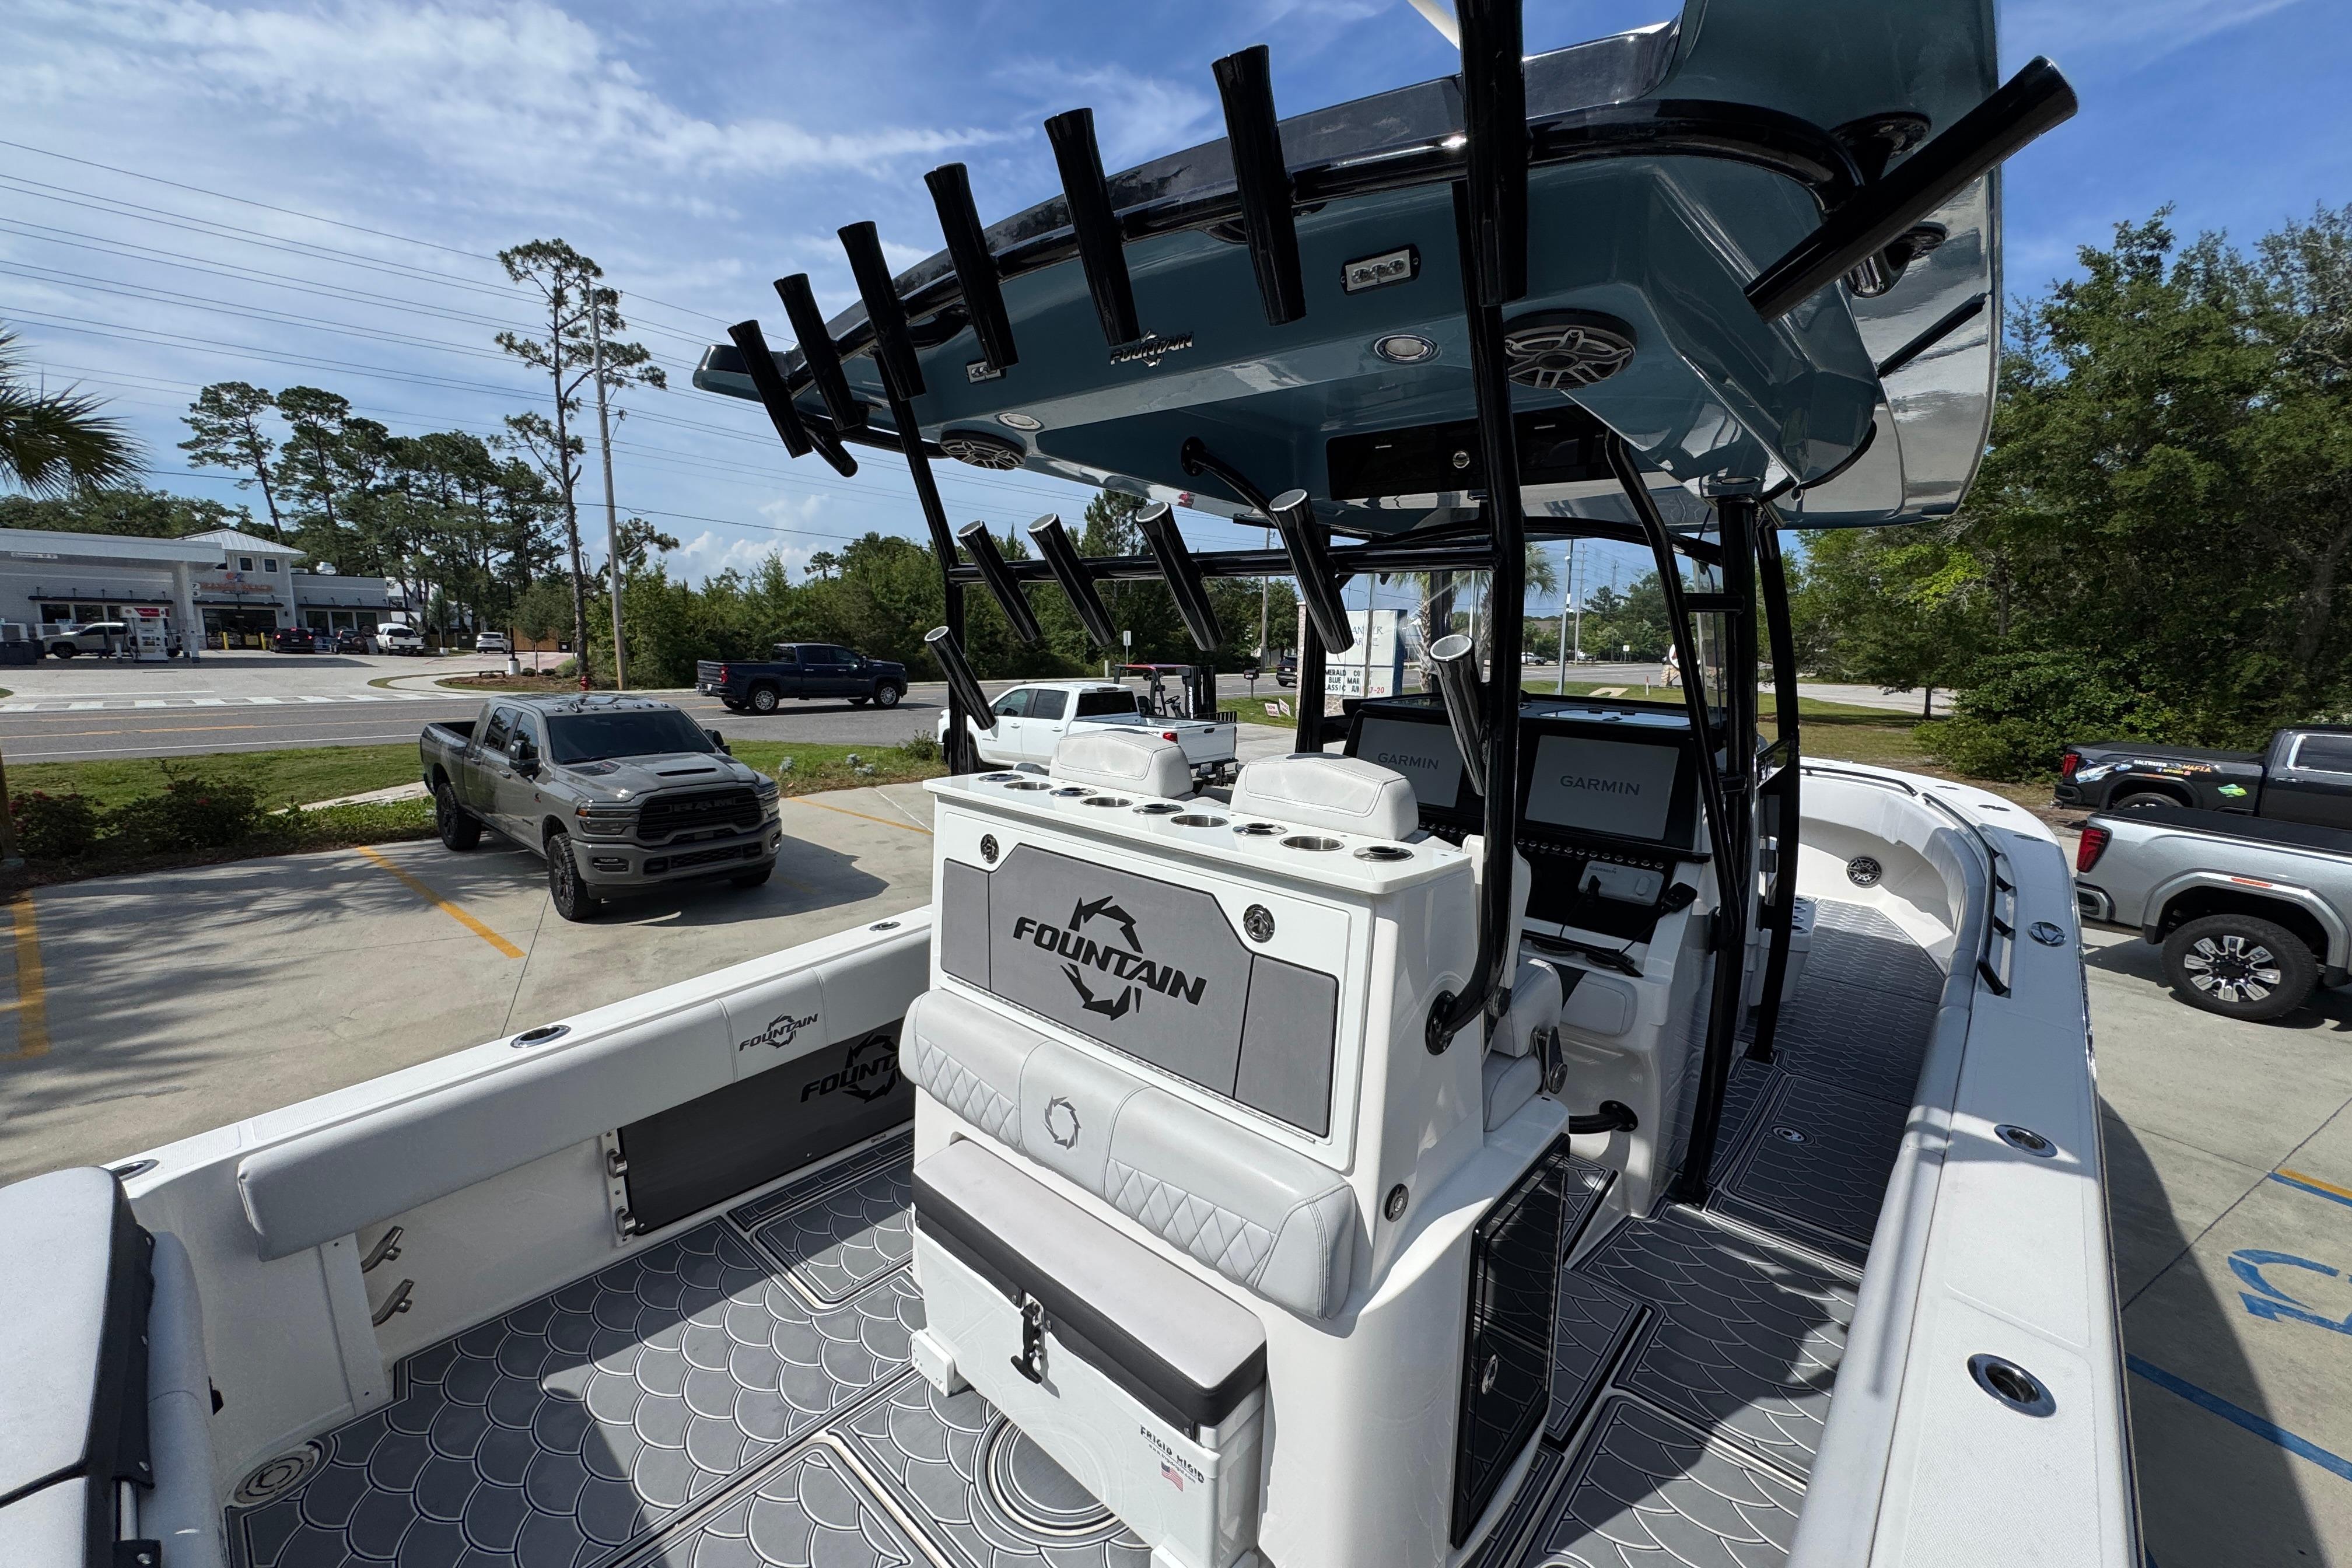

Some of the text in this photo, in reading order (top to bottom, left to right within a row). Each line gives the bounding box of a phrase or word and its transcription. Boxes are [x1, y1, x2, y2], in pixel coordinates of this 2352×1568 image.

[1110, 332, 1194, 365] FOUNTAIN
[1377, 752, 1439, 769] GARMIN
[2133, 760, 2212, 773] SALTWATER MAFIA
[1560, 775, 1640, 796] GARMIN
[674, 798, 734, 812] RAM
[1013, 916, 1208, 1006] FOUNTAIN
[738, 1013, 818, 1051] FOUNTAIN
[800, 1051, 899, 1103] FOUNT
[1140, 1424, 1172, 1455] FRIGID
